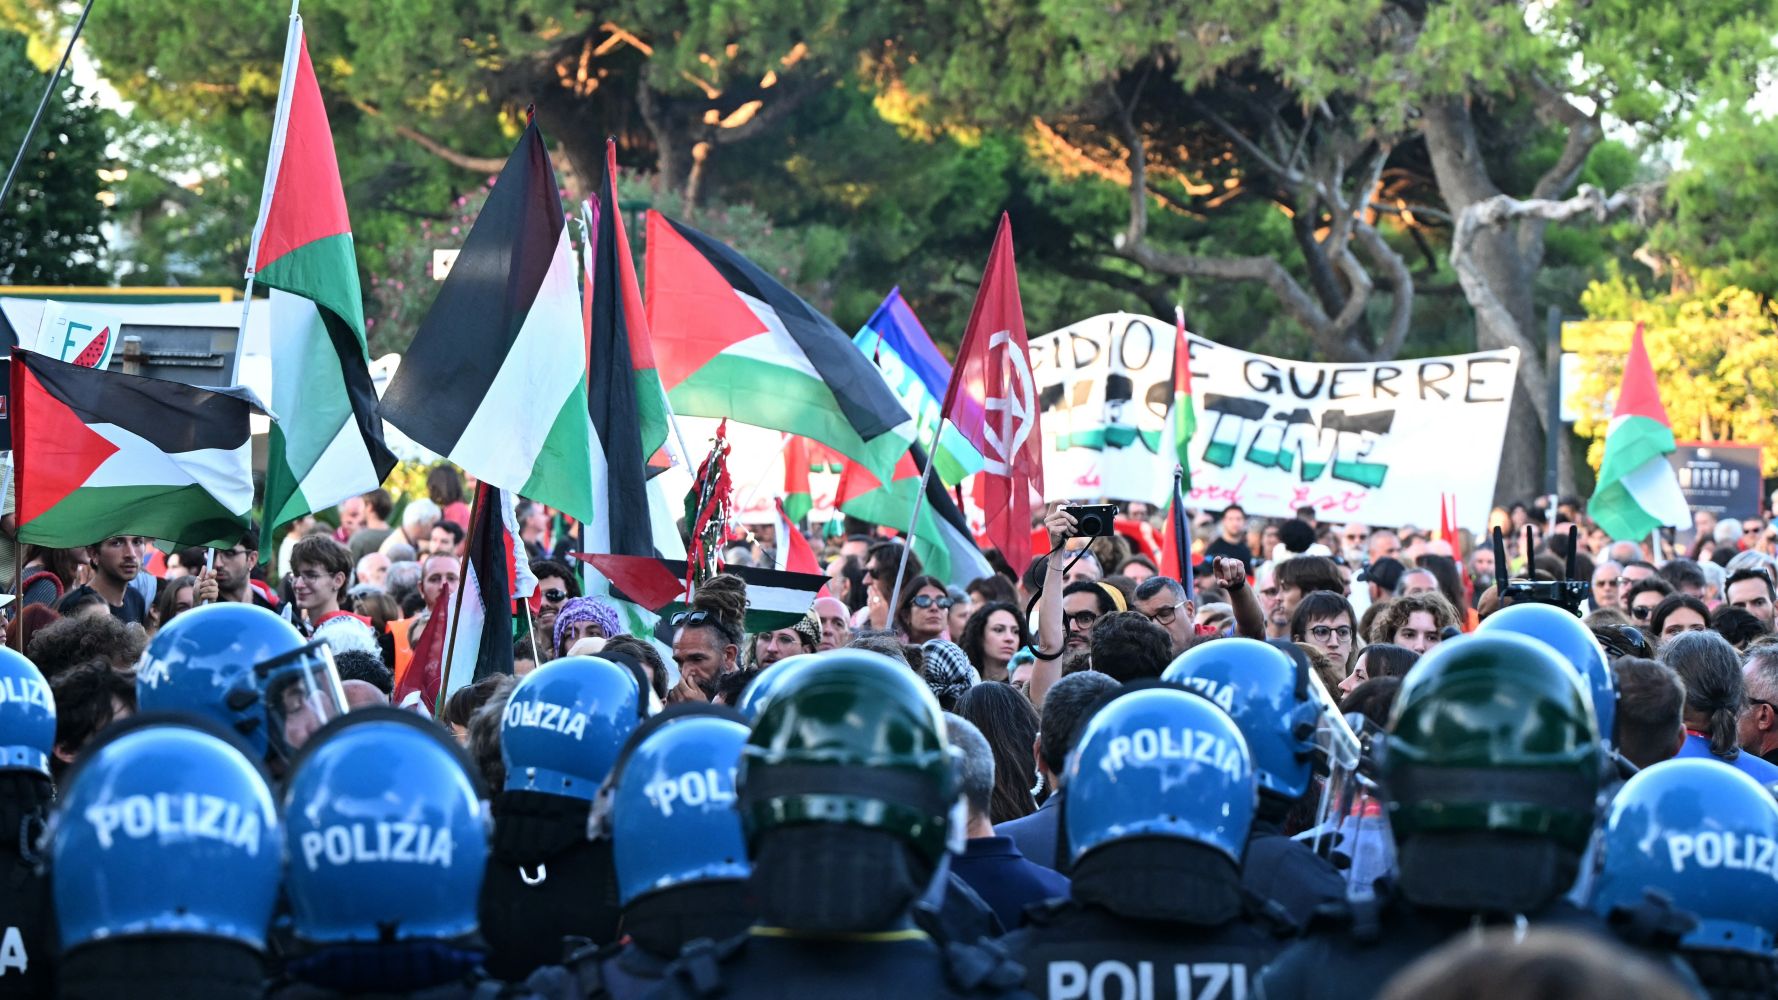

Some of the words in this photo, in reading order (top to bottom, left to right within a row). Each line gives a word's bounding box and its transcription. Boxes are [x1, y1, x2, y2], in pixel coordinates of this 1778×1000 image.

[1244, 357, 1511, 403] GUERRE
[1108, 726, 1242, 783] POLIZIA
[86, 792, 260, 856] POLIZIA
[302, 822, 452, 872] POLIZIA
[0, 926, 29, 977] A
